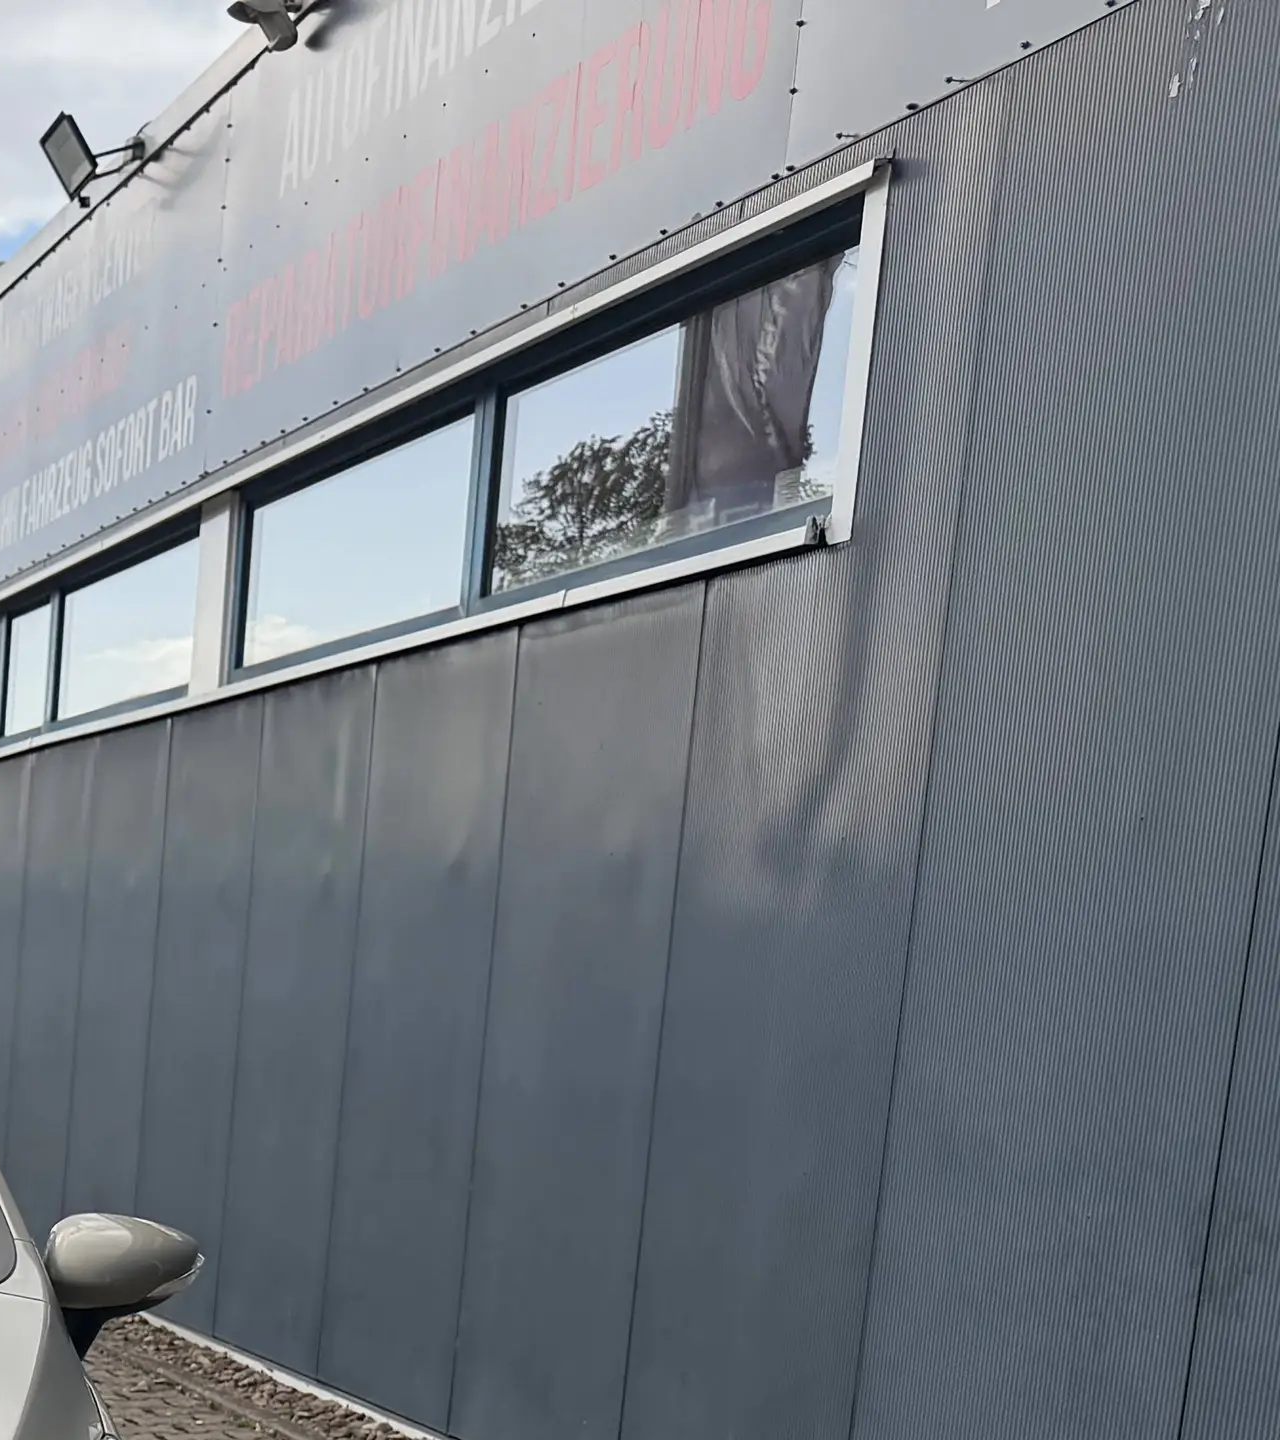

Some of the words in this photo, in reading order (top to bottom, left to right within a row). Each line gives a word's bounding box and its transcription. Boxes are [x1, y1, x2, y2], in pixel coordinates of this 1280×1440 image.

[221, 0, 770, 400] REPARATURFINANZIERUNG
[19, 439, 93, 540] FAHRZEUG
[92, 397, 158, 498] SOFORT
[158, 375, 198, 462] BAR
